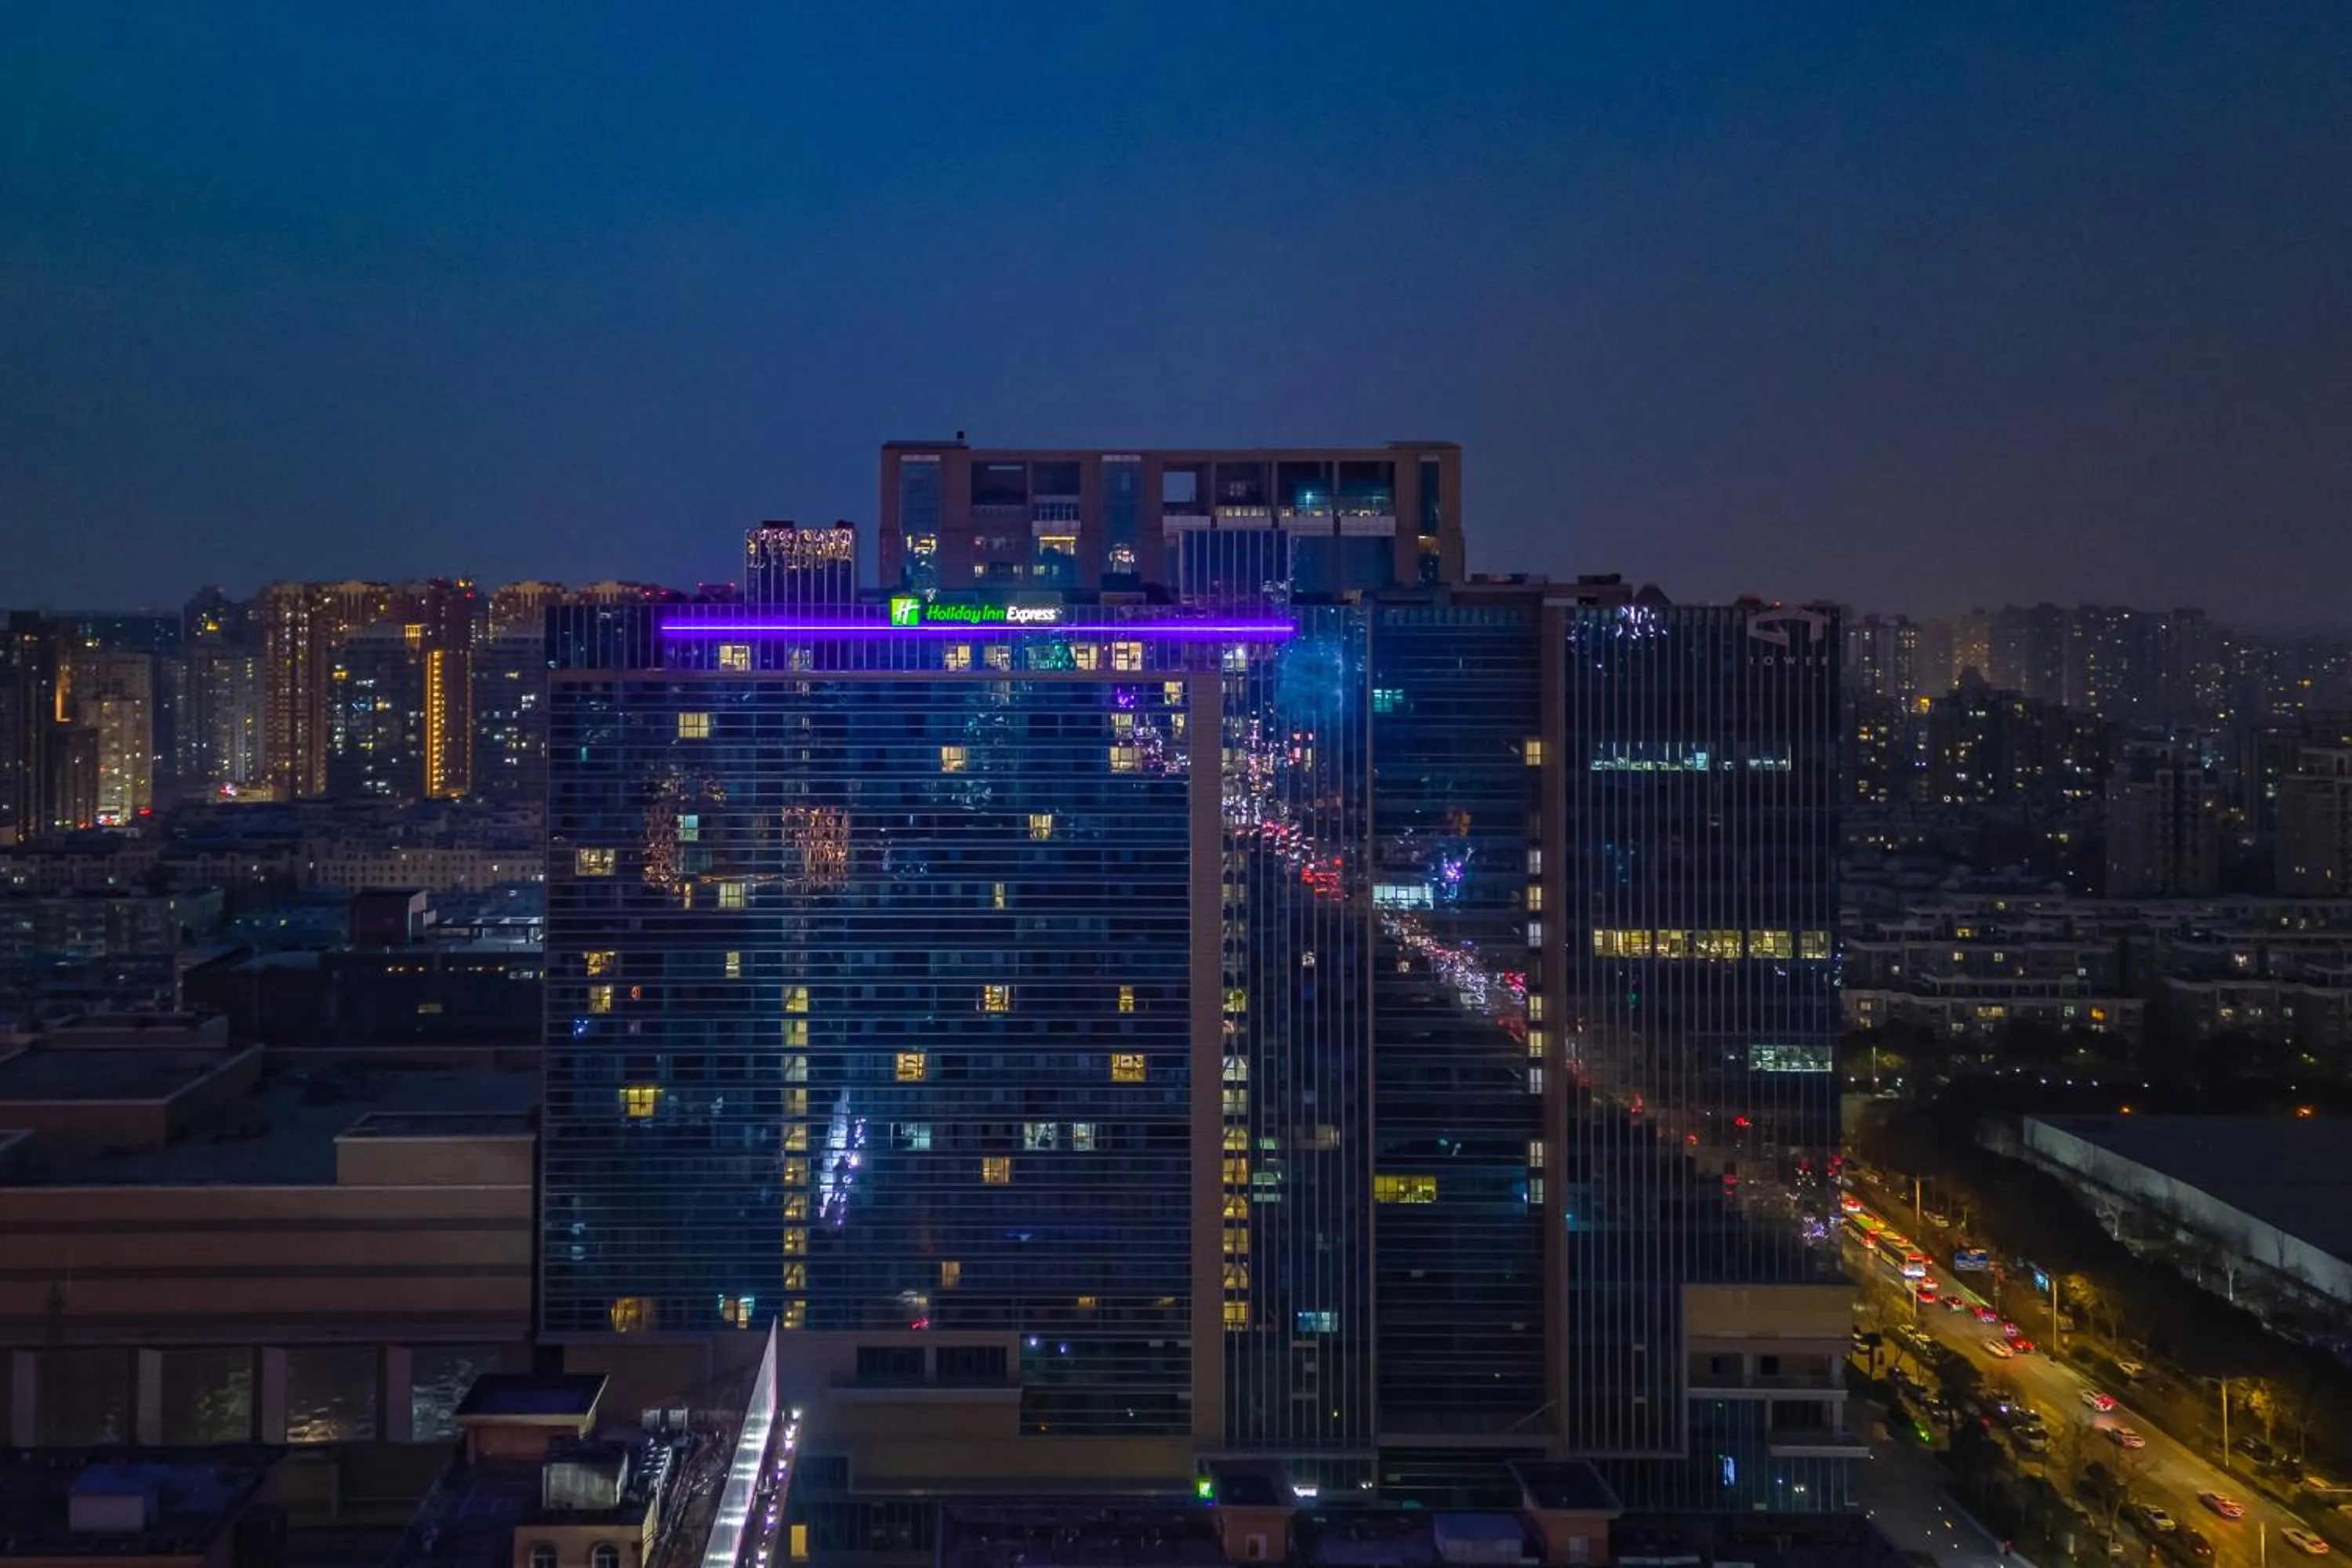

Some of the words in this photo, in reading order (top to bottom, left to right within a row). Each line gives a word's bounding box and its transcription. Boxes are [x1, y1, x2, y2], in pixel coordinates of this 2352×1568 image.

[927, 604, 980, 623] Holiday
[982, 604, 1004, 620] Inn
[1006, 606, 1055, 623] Express
